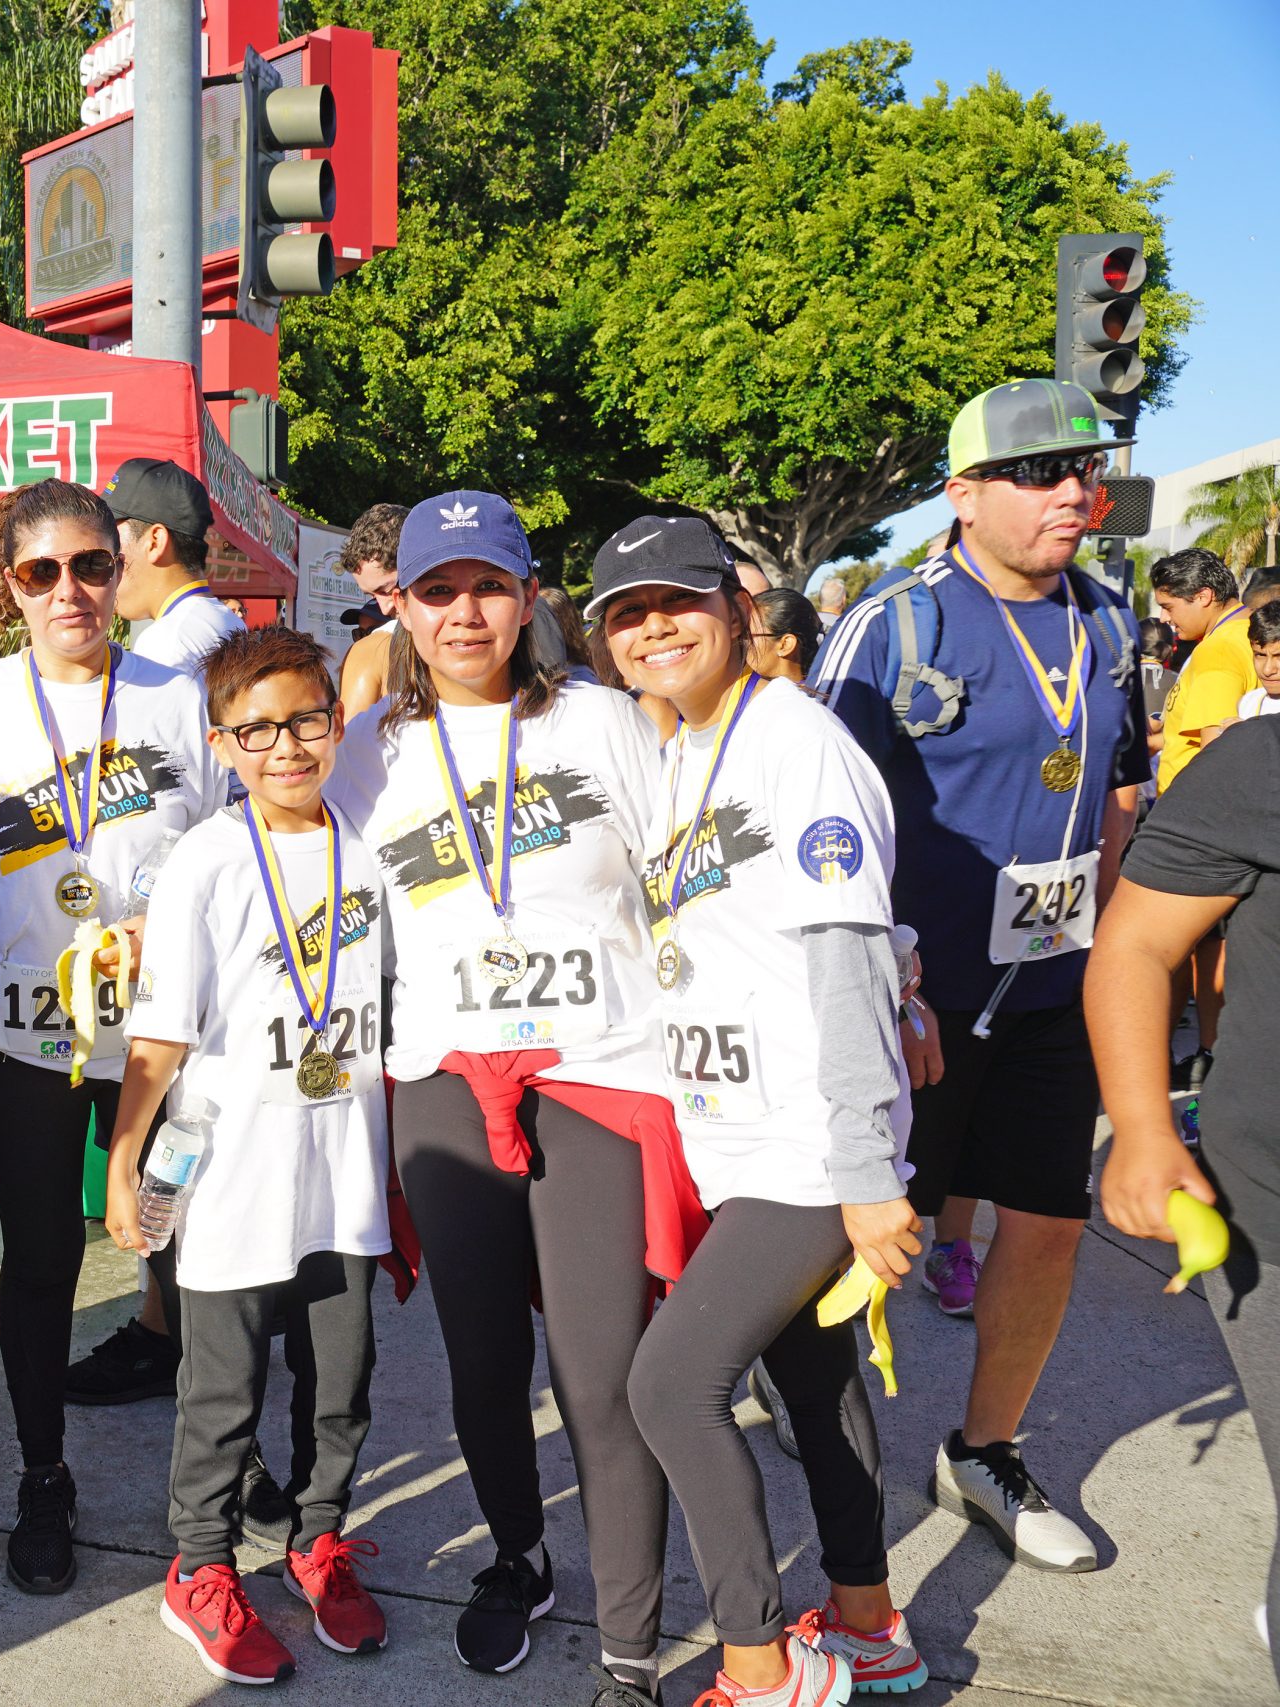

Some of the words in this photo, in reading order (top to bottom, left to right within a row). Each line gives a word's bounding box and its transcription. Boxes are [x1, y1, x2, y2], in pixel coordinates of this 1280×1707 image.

[441, 520, 479, 530] adidas
[312, 576, 342, 595] NORTHGATE
[100, 793, 149, 820] 10.19.19
[806, 829, 818, 841] City
[817, 823, 825, 831] of
[824, 820, 844, 828] Santa
[843, 825, 855, 837] Ana
[811, 835, 852, 860] 150
[683, 868, 723, 898] 10.19.19
[1010, 874, 1085, 929] 292
[299, 915, 326, 940] SANT
[343, 925, 368, 944] 10.19.19
[21, 968, 40, 977] CITY
[41, 969, 53, 978] OF
[4, 980, 124, 1030] 129
[537, 1037, 555, 1045] RUN
[337, 1088, 352, 1096] RUN
